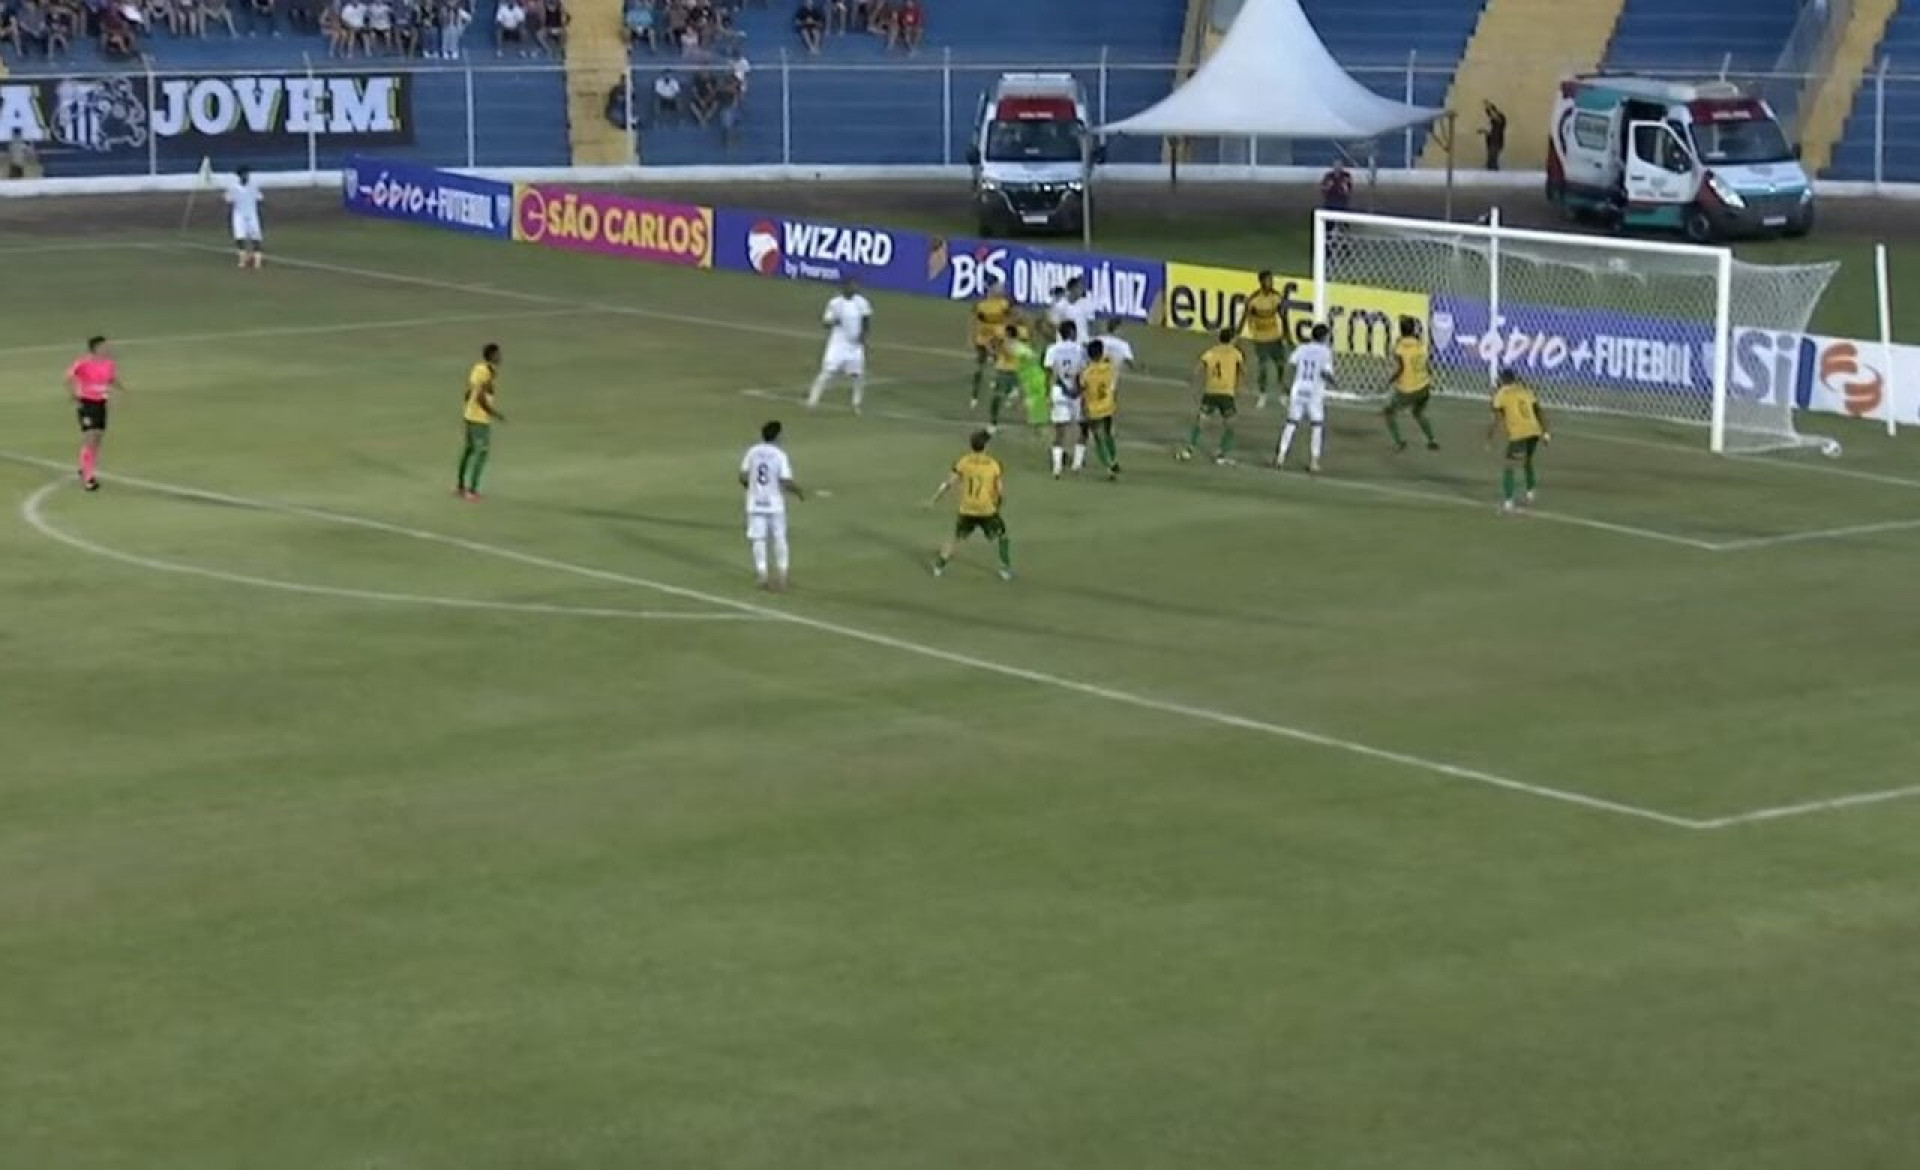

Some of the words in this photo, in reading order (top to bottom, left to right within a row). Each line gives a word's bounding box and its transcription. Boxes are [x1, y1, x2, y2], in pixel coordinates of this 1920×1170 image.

[153, 77, 396, 136] JOVEM
[549, 194, 599, 240] SÃO
[603, 206, 706, 256] CARLOS
[783, 221, 893, 266] WIZARD
[1114, 269, 1148, 316] DIZ
[757, 462, 769, 486] 8
